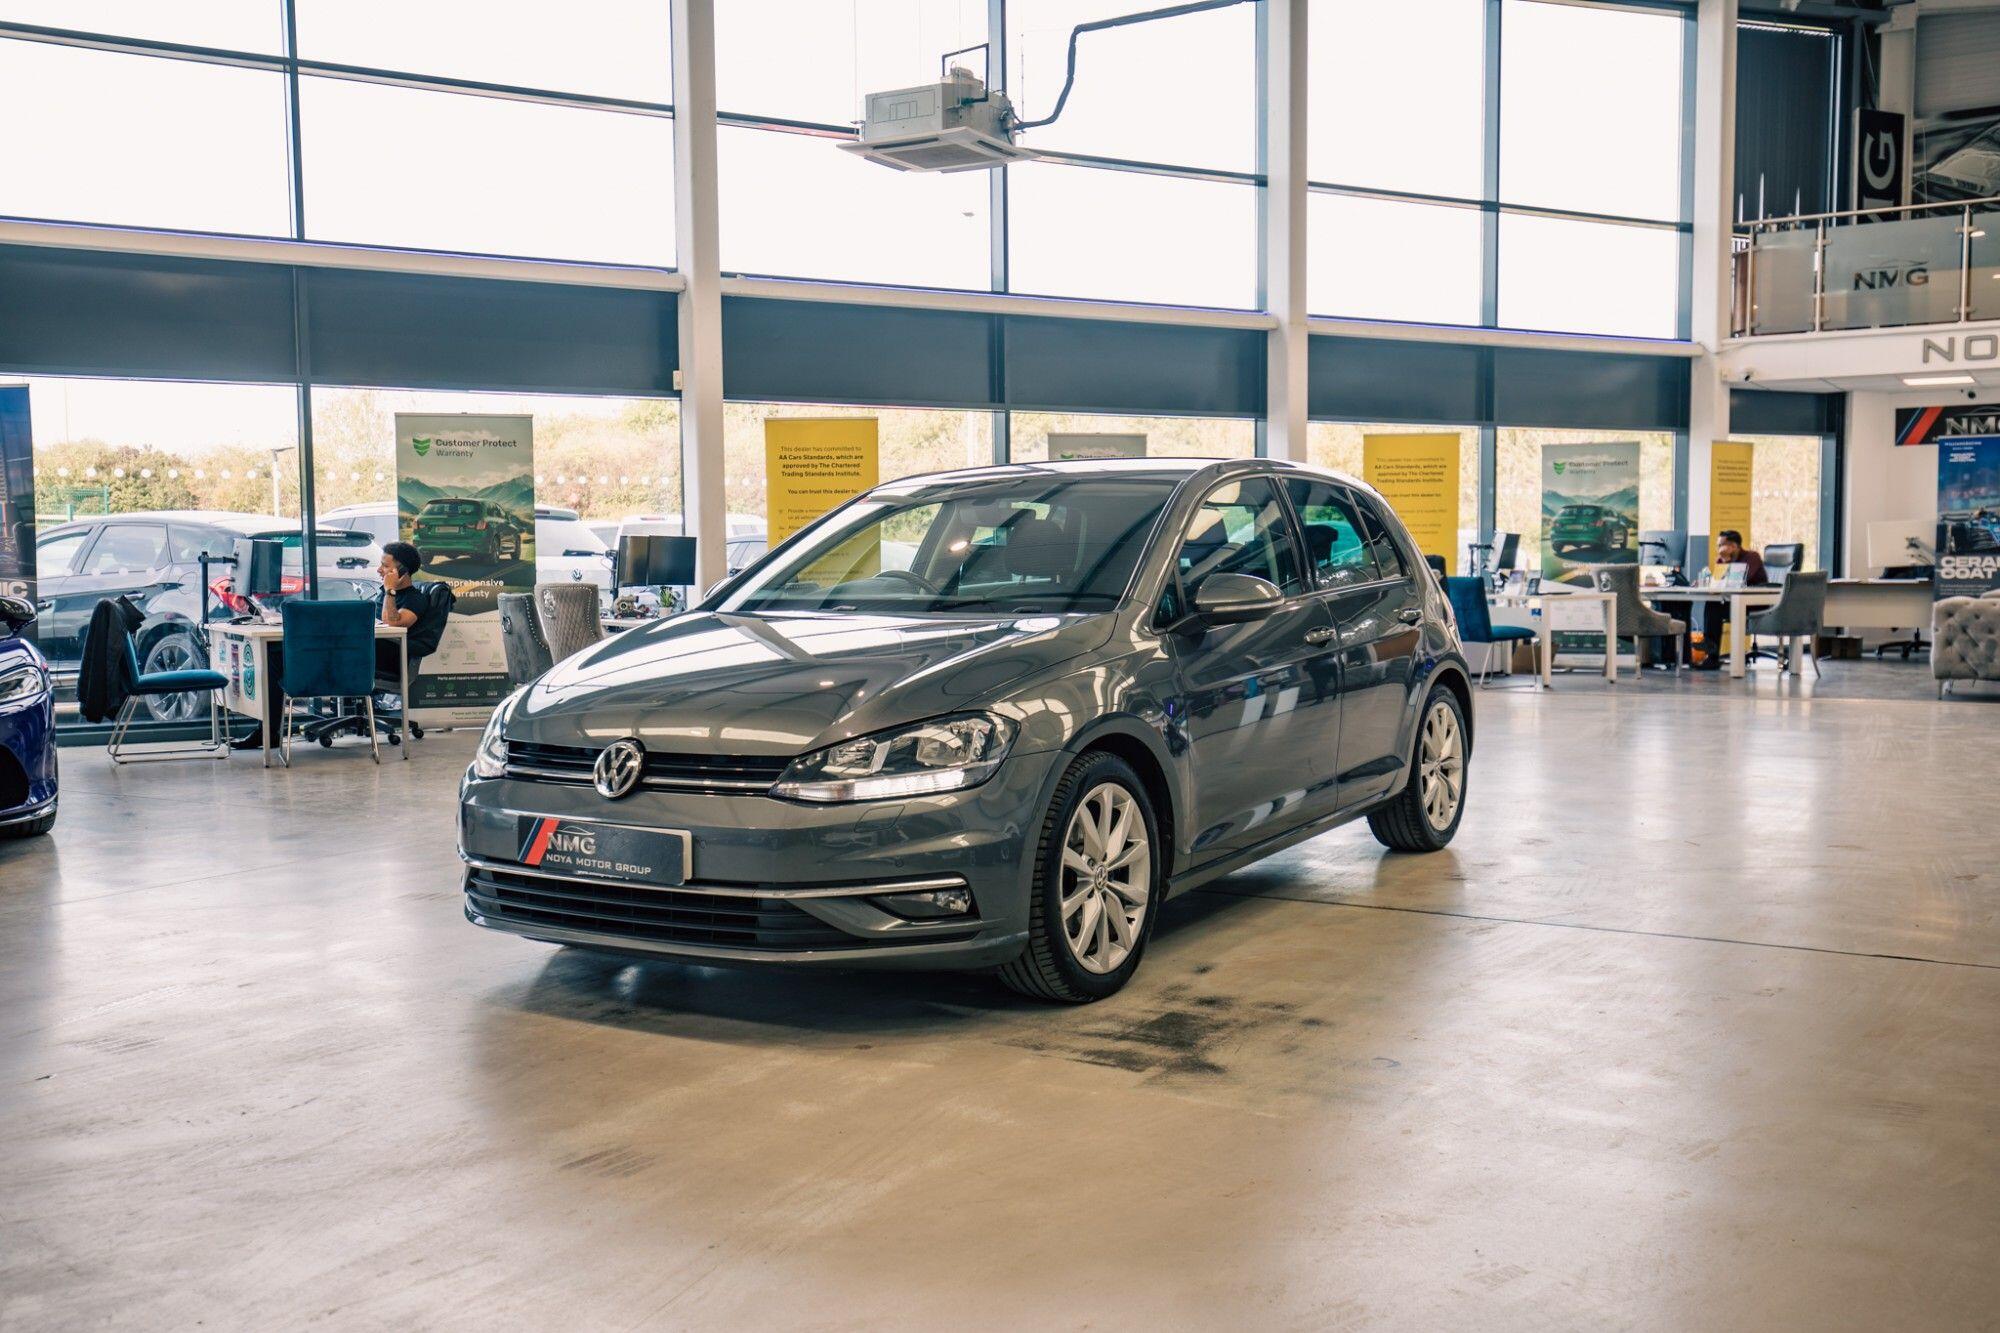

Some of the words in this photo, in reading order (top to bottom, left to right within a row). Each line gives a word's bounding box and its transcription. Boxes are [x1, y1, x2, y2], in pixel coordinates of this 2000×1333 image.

[1854, 268, 1930, 291] NMG
[1946, 416, 2000, 436] NM
[435, 439, 480, 447] Customer
[483, 439, 518, 447] Protect
[436, 450, 474, 458] Warranty
[1941, 556, 2000, 568] CERA
[1940, 568, 1997, 579] COAT
[452, 590, 490, 599] arranty
[547, 832, 596, 855] NMG
[546, 854, 572, 864] NOYA
[576, 857, 611, 869] MOTOR
[615, 862, 652, 874] GROUP
